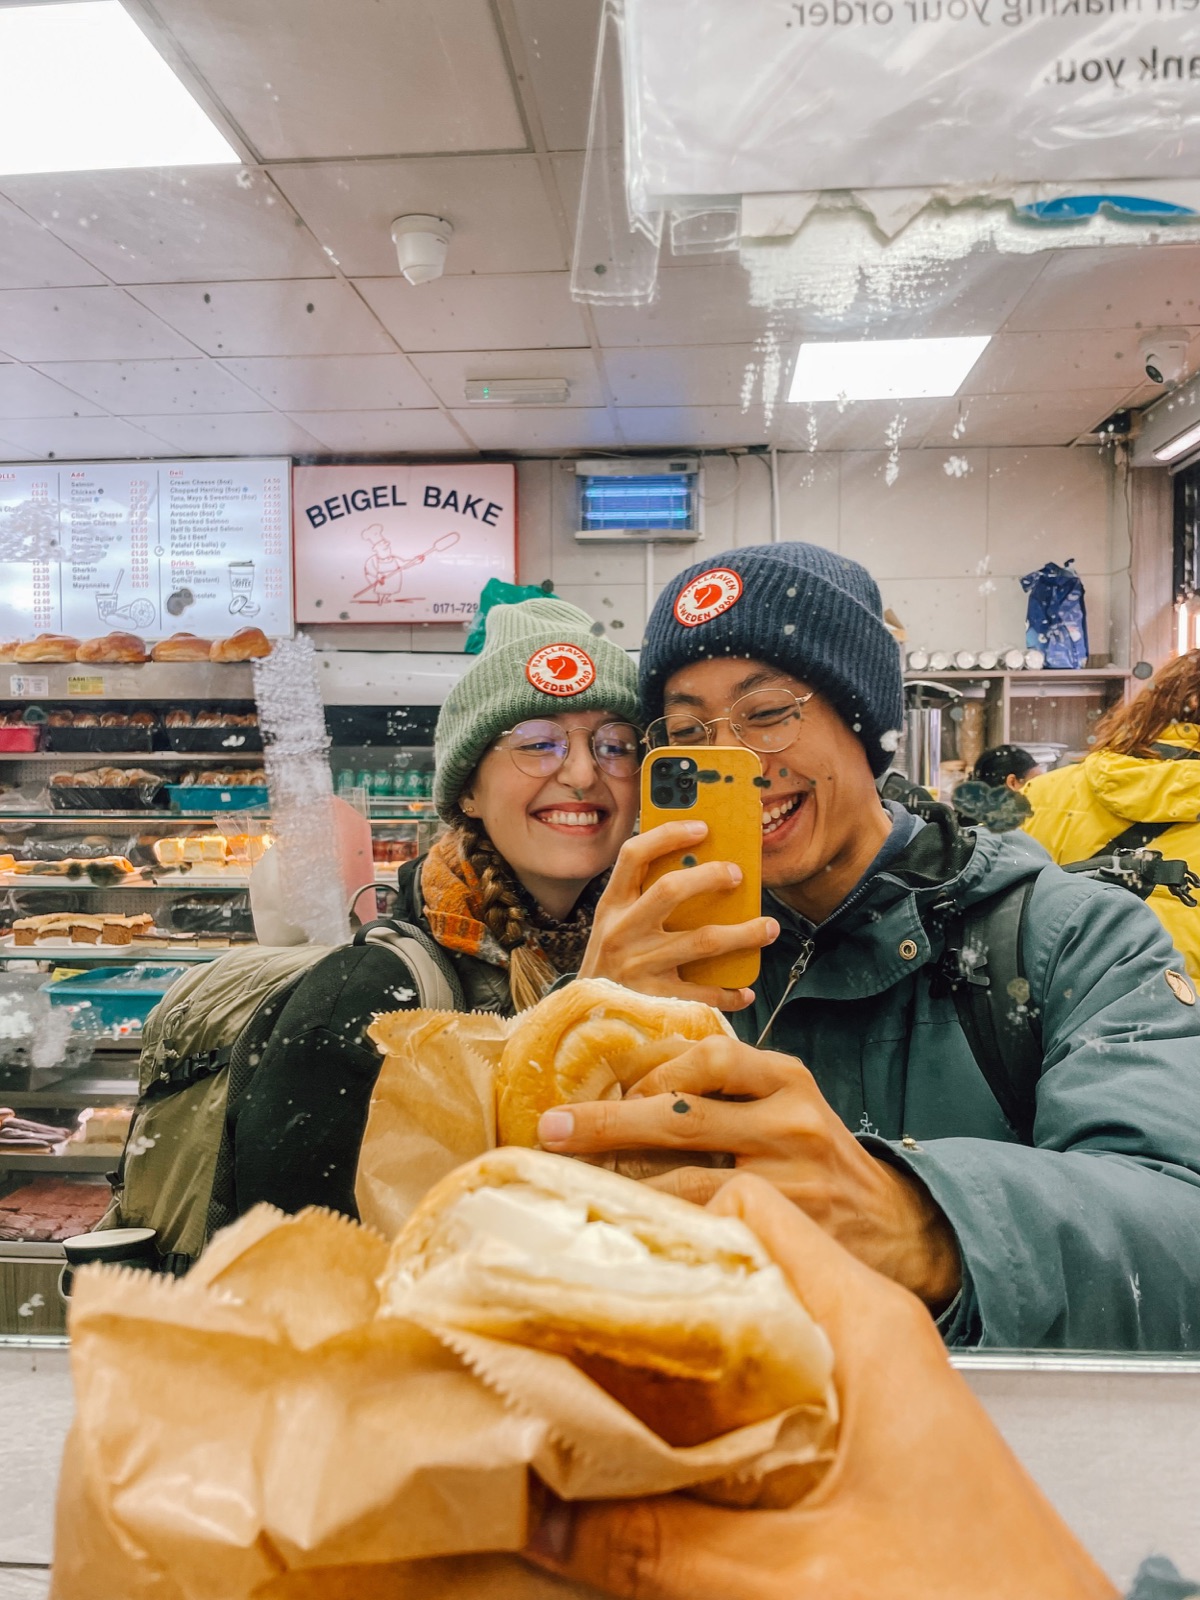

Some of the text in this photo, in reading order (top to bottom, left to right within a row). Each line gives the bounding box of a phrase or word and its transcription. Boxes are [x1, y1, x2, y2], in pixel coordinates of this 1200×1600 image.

[306, 485, 504, 529] BEIGEL BAKE
[679, 595, 735, 622] SWEDEN 1960
[532, 670, 591, 692] SWEDEN 1960
